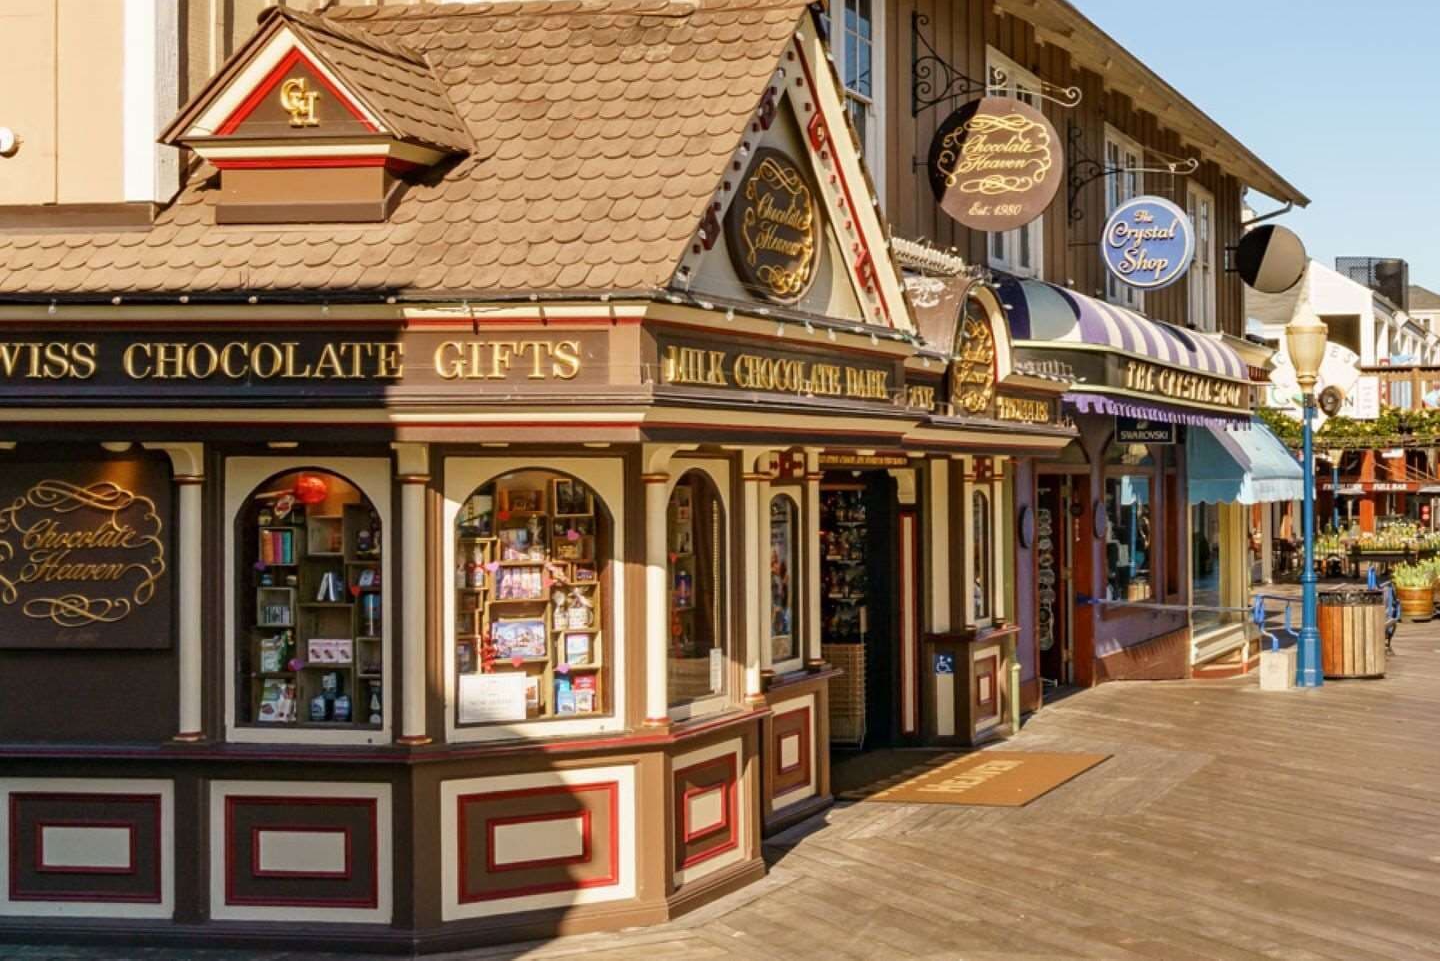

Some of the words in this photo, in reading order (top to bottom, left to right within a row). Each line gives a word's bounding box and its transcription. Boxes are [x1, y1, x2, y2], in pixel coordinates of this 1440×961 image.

[961, 133, 1034, 155] Chocolate
[957, 152, 1029, 172] Heaven
[1108, 217, 1178, 248] Crystal
[1118, 246, 1169, 280] Shop
[122, 341, 403, 379] CHOCOLATE
[433, 340, 581, 379] GIFTS
[664, 345, 728, 385] MILK
[734, 353, 842, 395] CHOCOLATE
[845, 366, 890, 400] DARK
[1127, 360, 1155, 392] THE
[1159, 368, 1211, 402] CRYSTAL
[1213, 382, 1241, 406] SHOP
[1120, 430, 1169, 441] SWAROVSKI
[23, 518, 137, 551] Chocolate
[20, 549, 128, 582] Heaven
